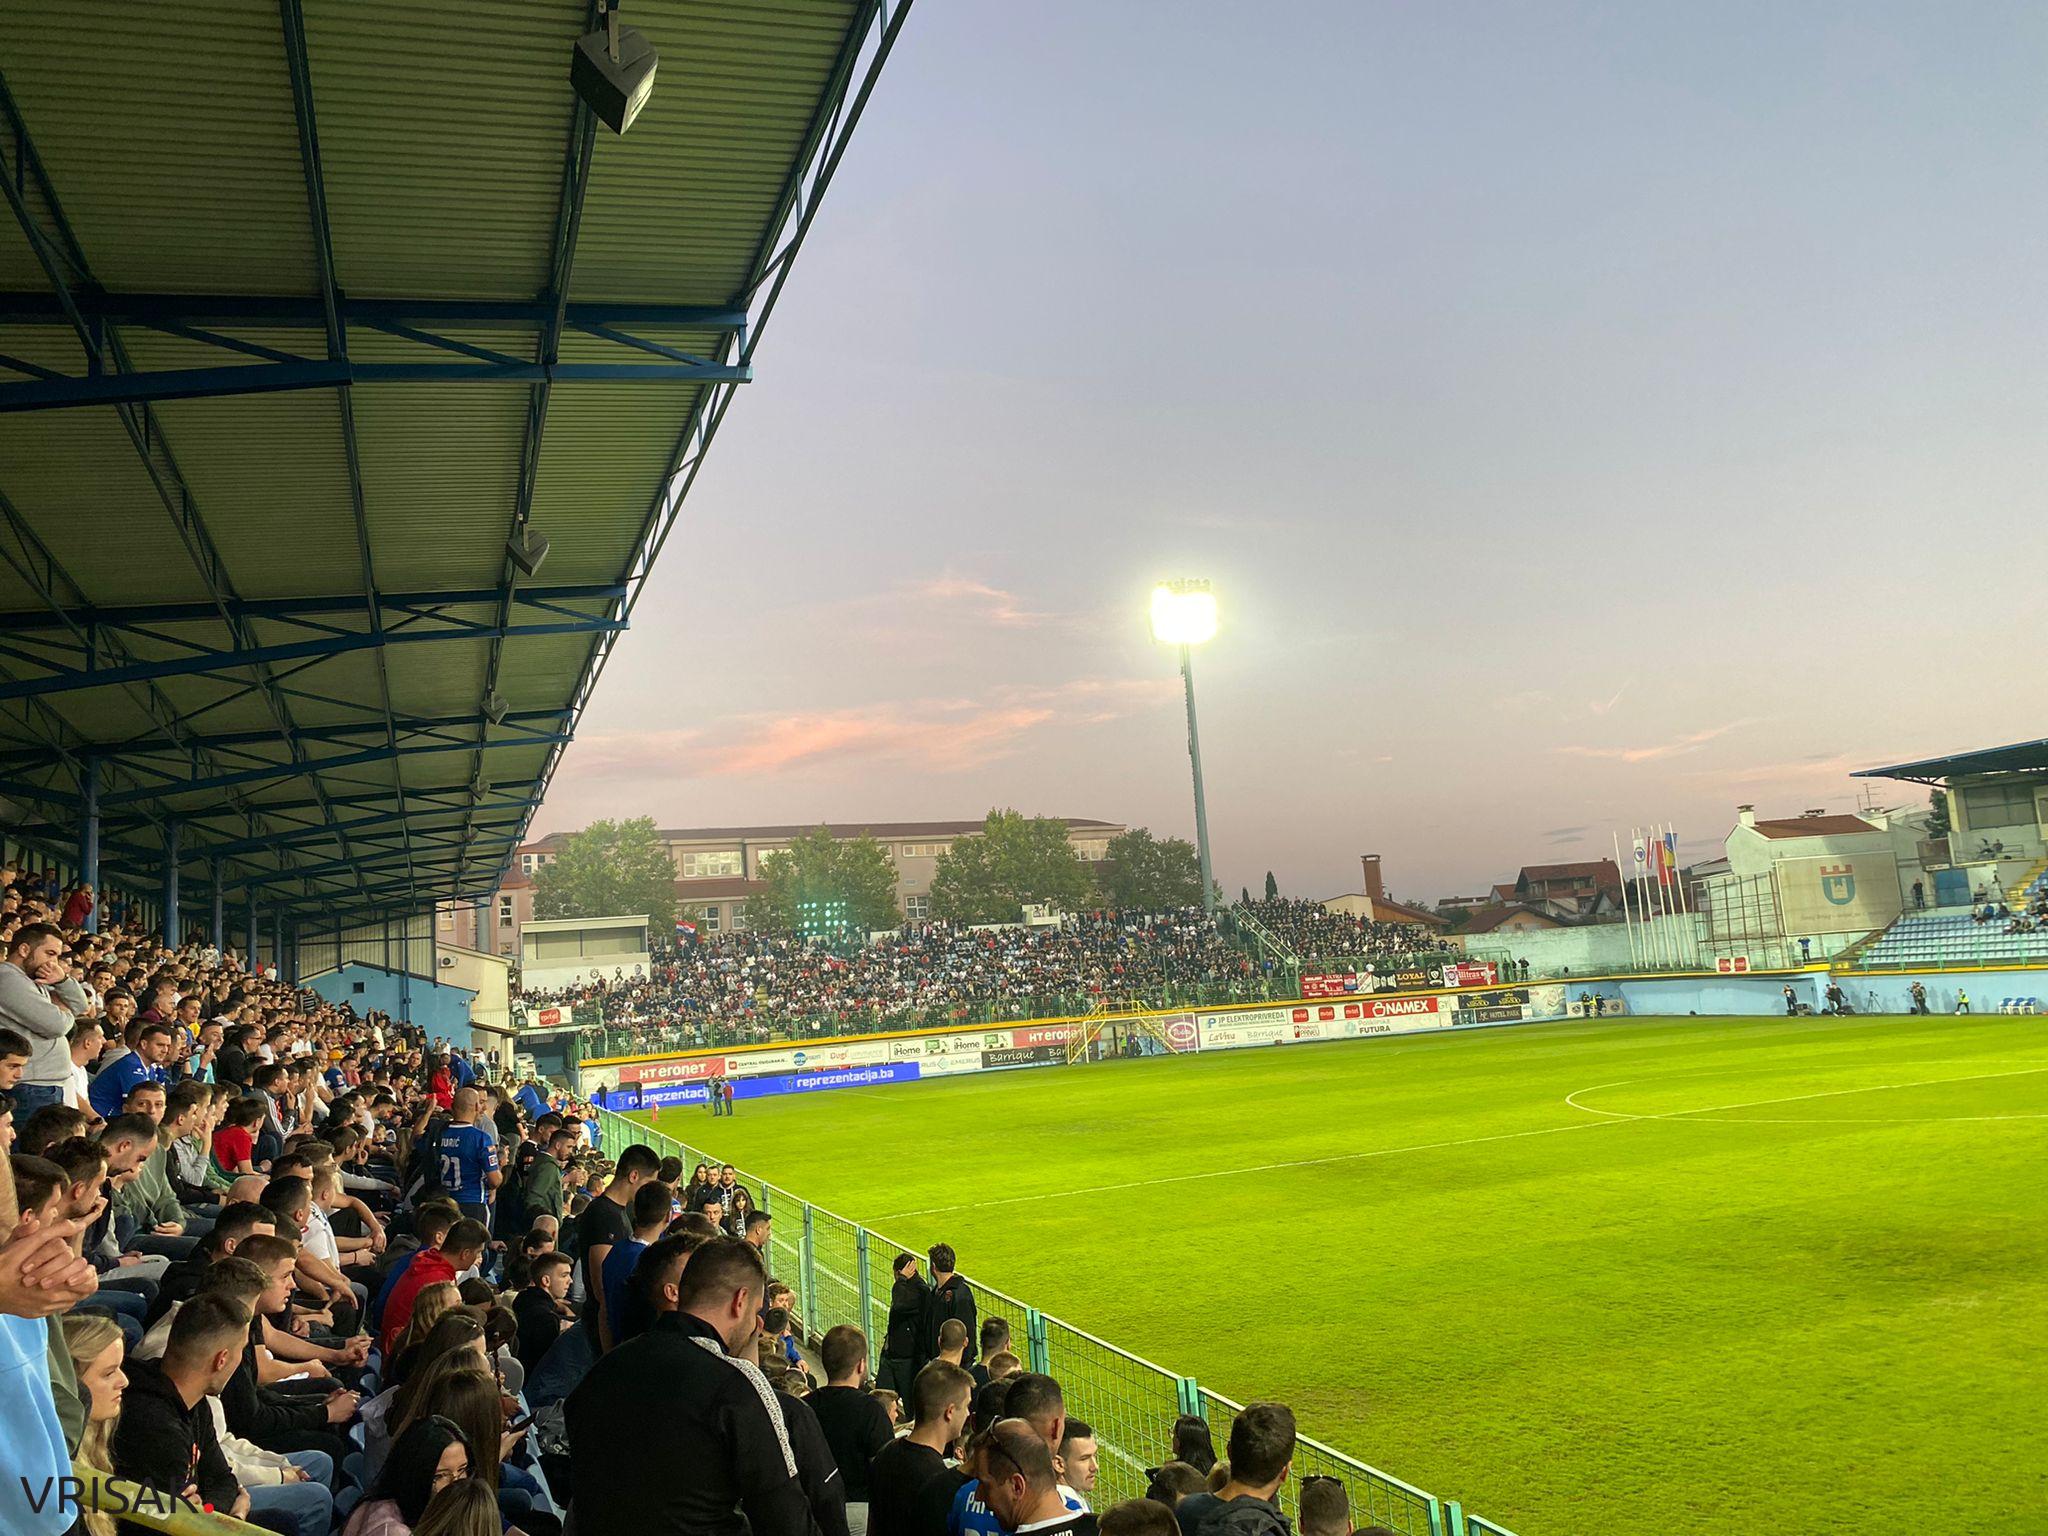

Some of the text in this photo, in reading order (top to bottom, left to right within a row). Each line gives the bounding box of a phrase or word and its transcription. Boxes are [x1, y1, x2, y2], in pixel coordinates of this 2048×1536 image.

[1385, 1000, 1429, 1016] NAMEX
[1359, 1025, 1391, 1034] FUTURA
[989, 1050, 1035, 1064] Barrique
[640, 1069, 657, 1079] HT
[797, 1069, 894, 1088] reprezentacija.ba
[440, 1154, 462, 1191] 21
